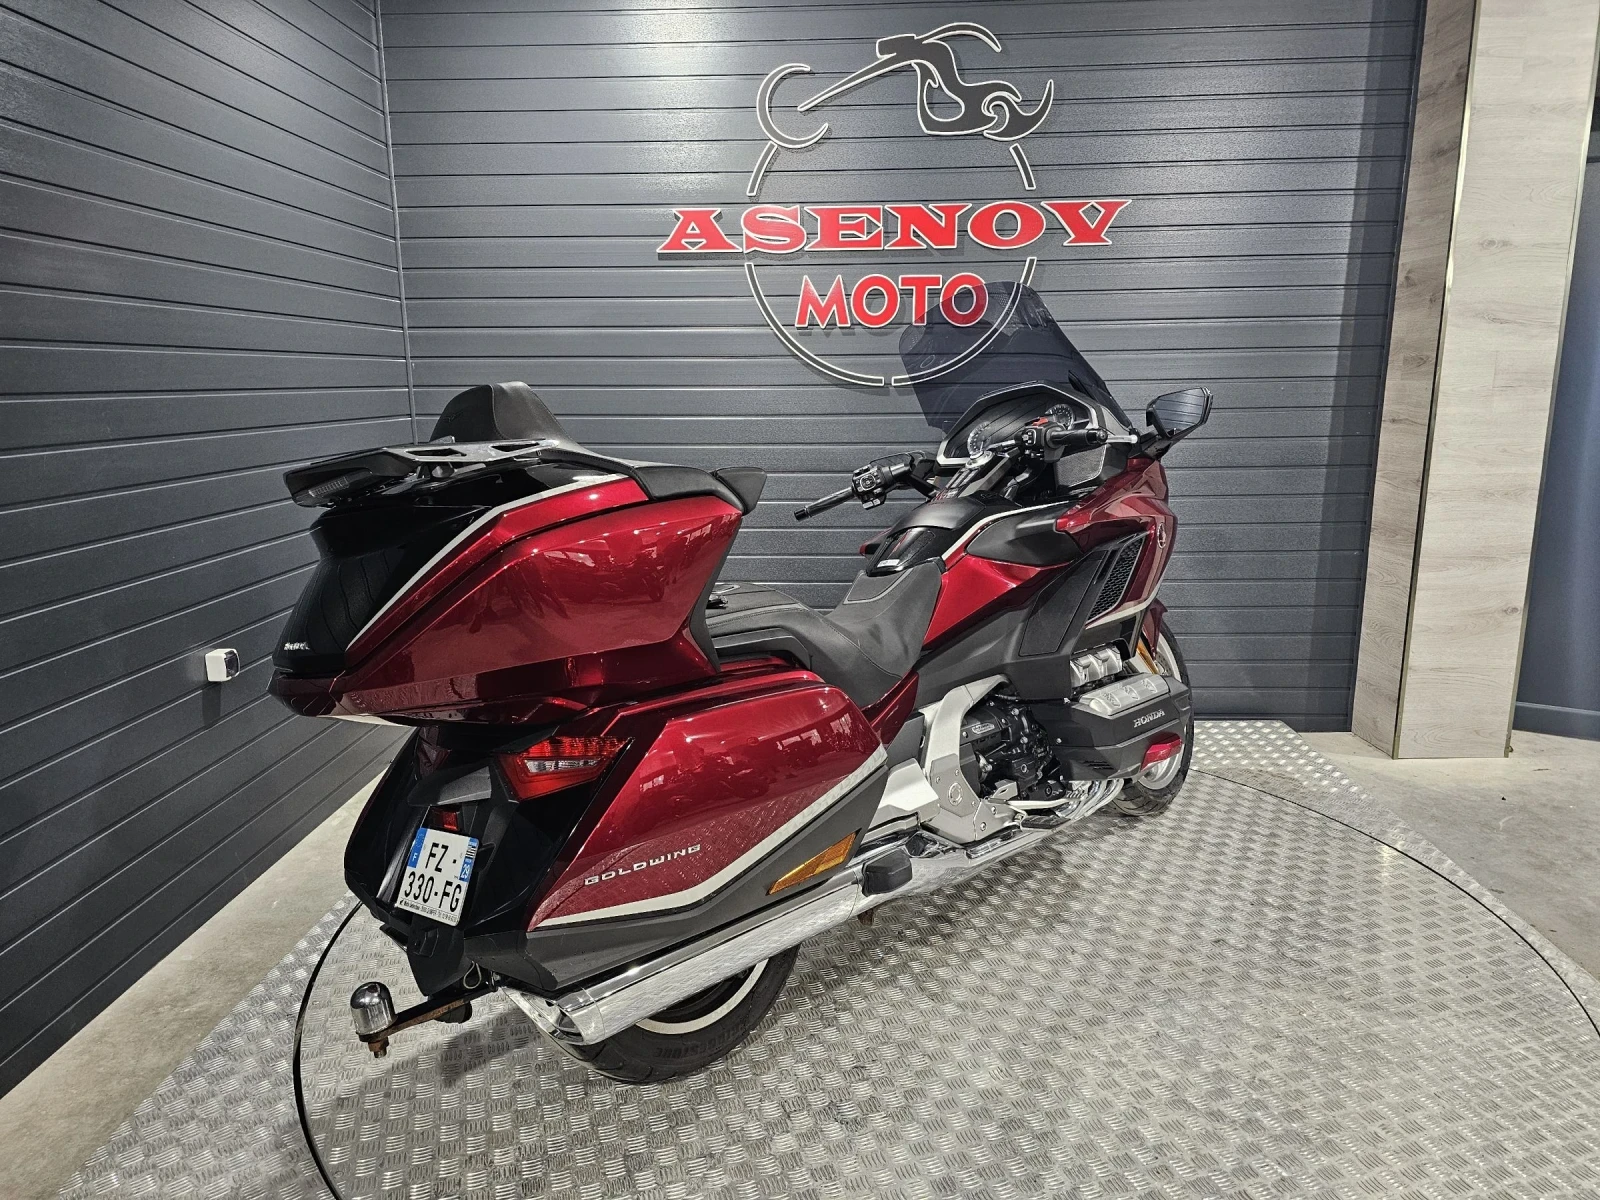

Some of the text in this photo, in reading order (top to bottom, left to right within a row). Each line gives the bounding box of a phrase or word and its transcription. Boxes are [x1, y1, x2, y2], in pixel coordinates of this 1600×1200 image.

[794, 272, 989, 329] MOTO
[1133, 708, 1166, 728] HONDA
[584, 843, 701, 886] GOLDWING
[404, 871, 462, 913] 330-FG
